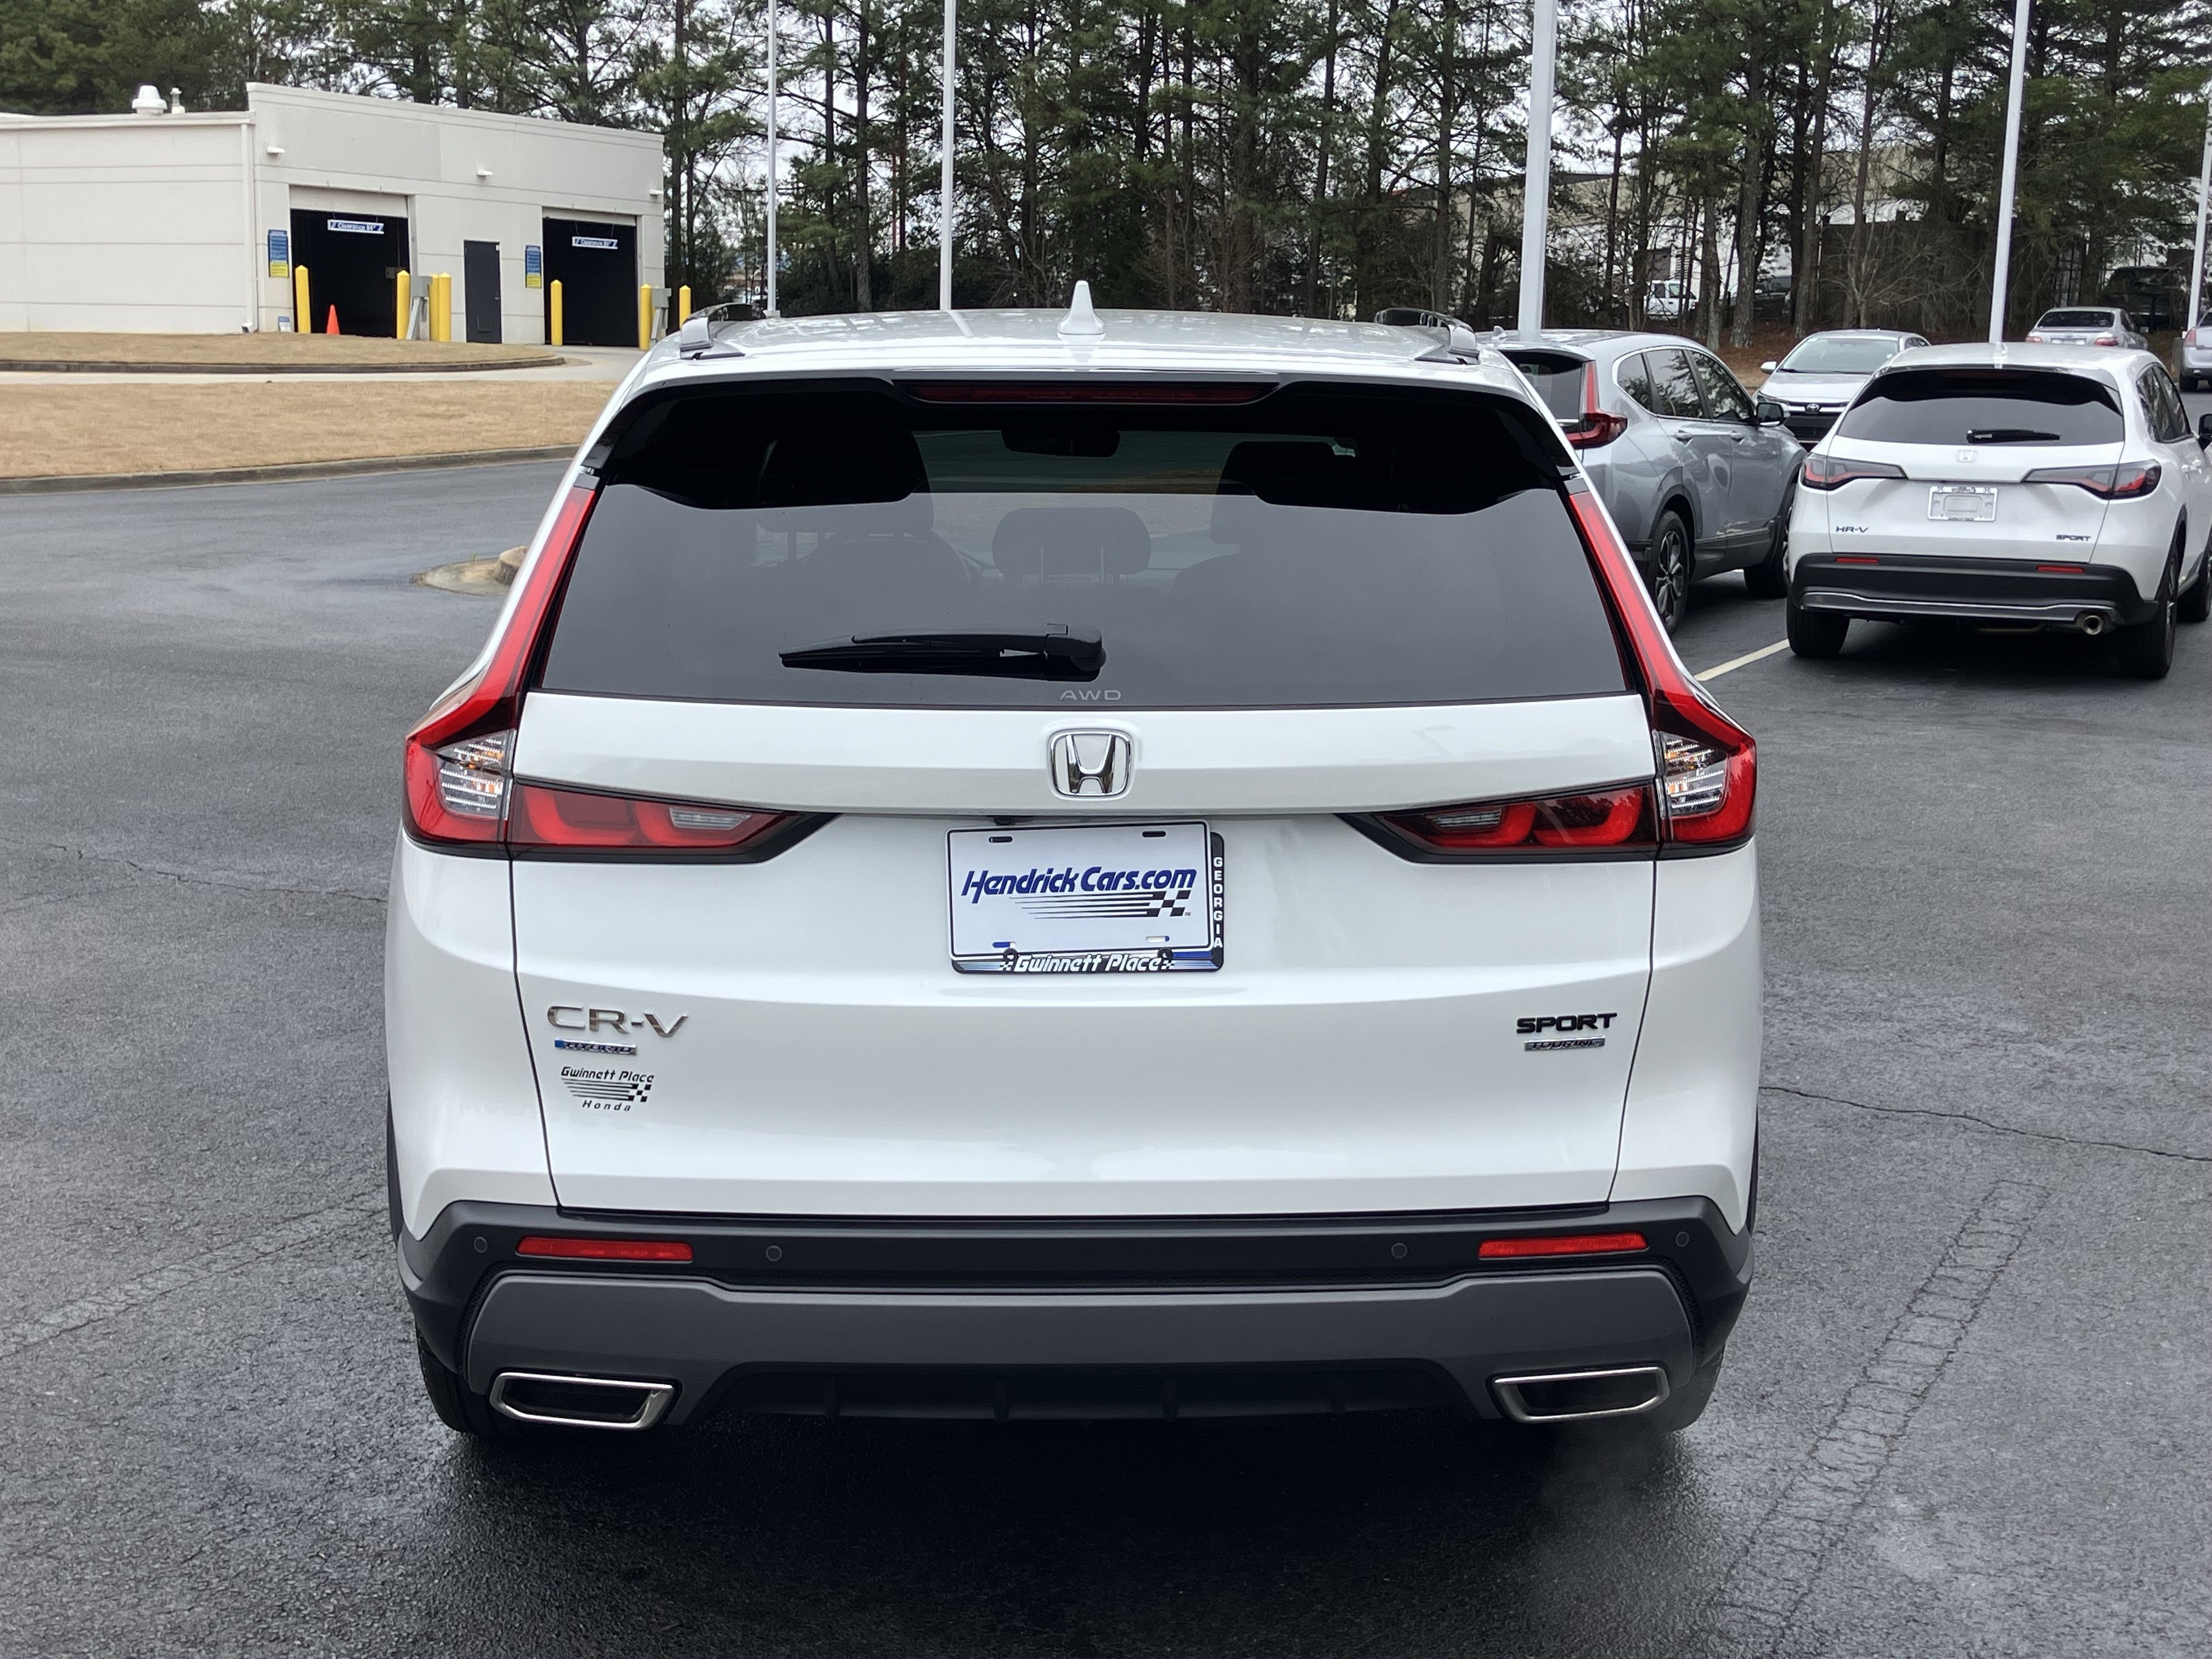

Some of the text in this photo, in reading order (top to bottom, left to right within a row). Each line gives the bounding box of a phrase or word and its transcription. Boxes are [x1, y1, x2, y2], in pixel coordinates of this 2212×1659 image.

[1059, 690, 1121, 701] AWD
[1213, 856, 1223, 948] GEORGIA
[1014, 953, 1162, 972] Gwinnett Place
[547, 1006, 689, 1037] CR-V
[1516, 1013, 1617, 1034] SPORT
[564, 1042, 631, 1055] HYBRID
[1530, 1039, 1600, 1051] TOURING
[561, 1066, 654, 1083] Gwinnett Place
[582, 1099, 631, 1111] Honda
